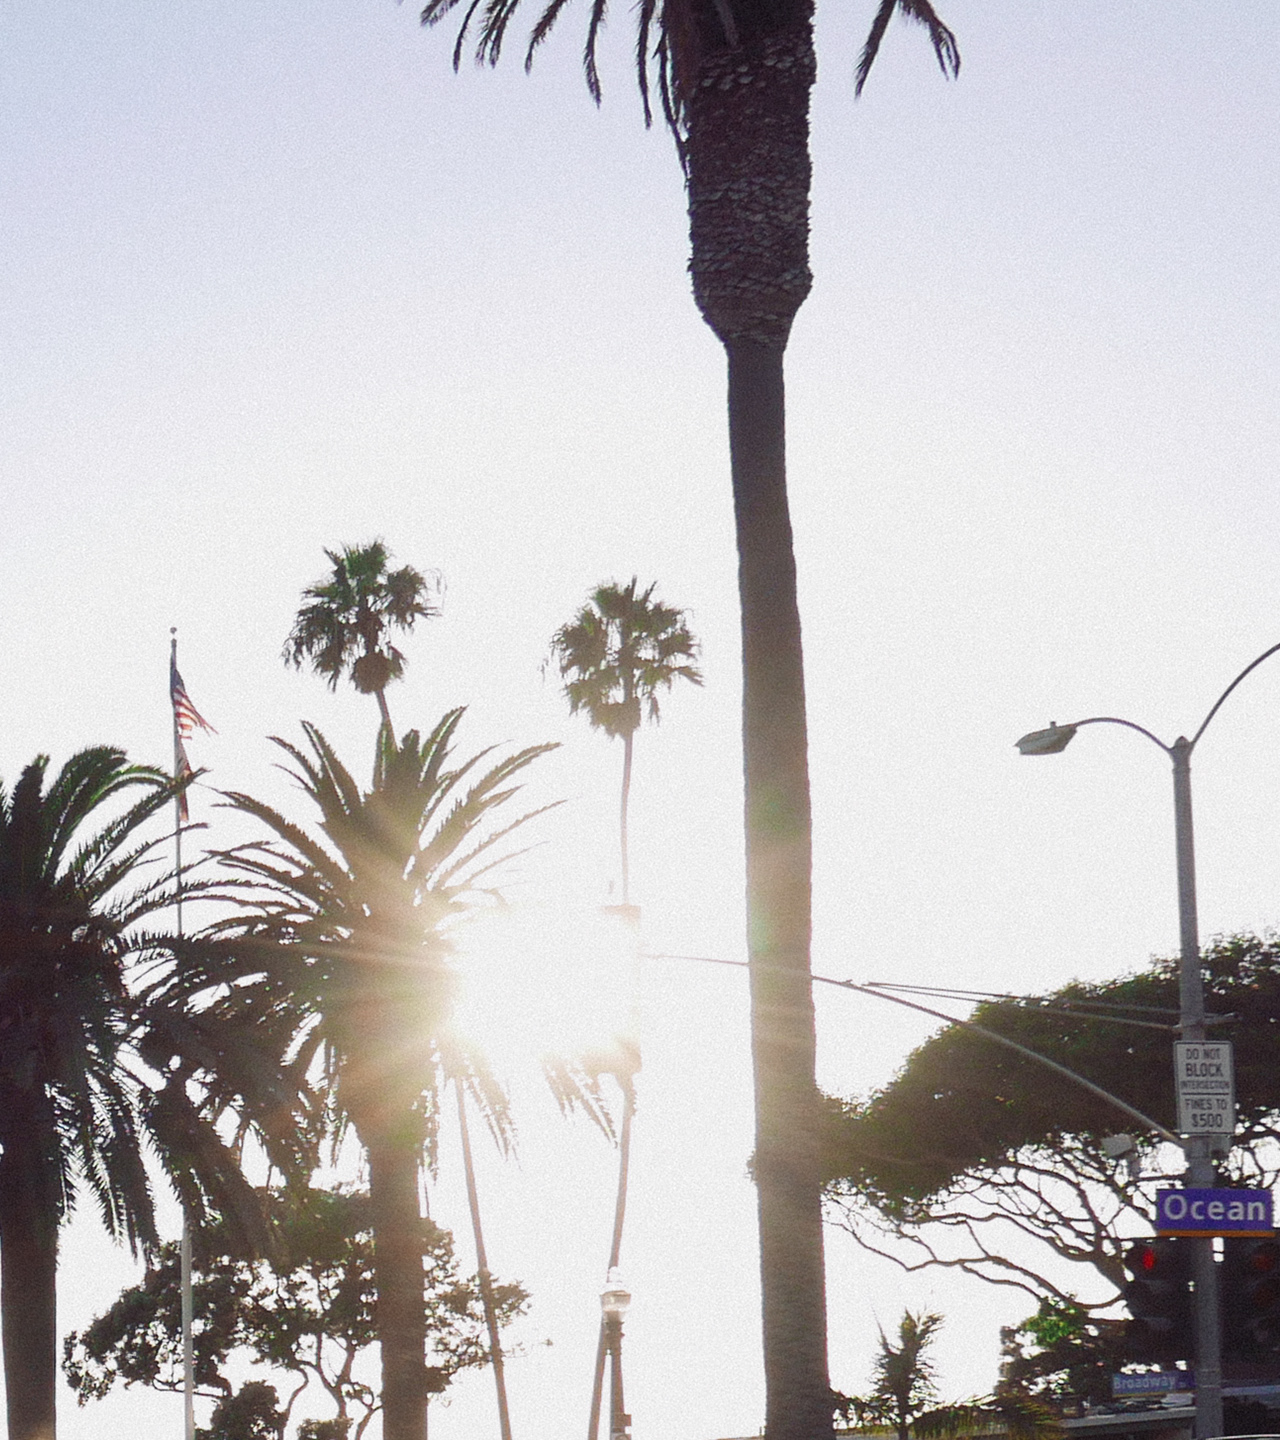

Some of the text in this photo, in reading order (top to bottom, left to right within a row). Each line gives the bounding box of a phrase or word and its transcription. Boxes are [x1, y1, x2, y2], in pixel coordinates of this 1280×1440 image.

[1186, 1047, 1221, 1060] DO NOT
[1185, 1063, 1224, 1077] BLOCK
[1185, 1099, 1228, 1110] FINES TO
[1191, 1113, 1223, 1127] $500
[1163, 1194, 1265, 1221] Ocean
[1113, 1375, 1176, 1390] Broadway
